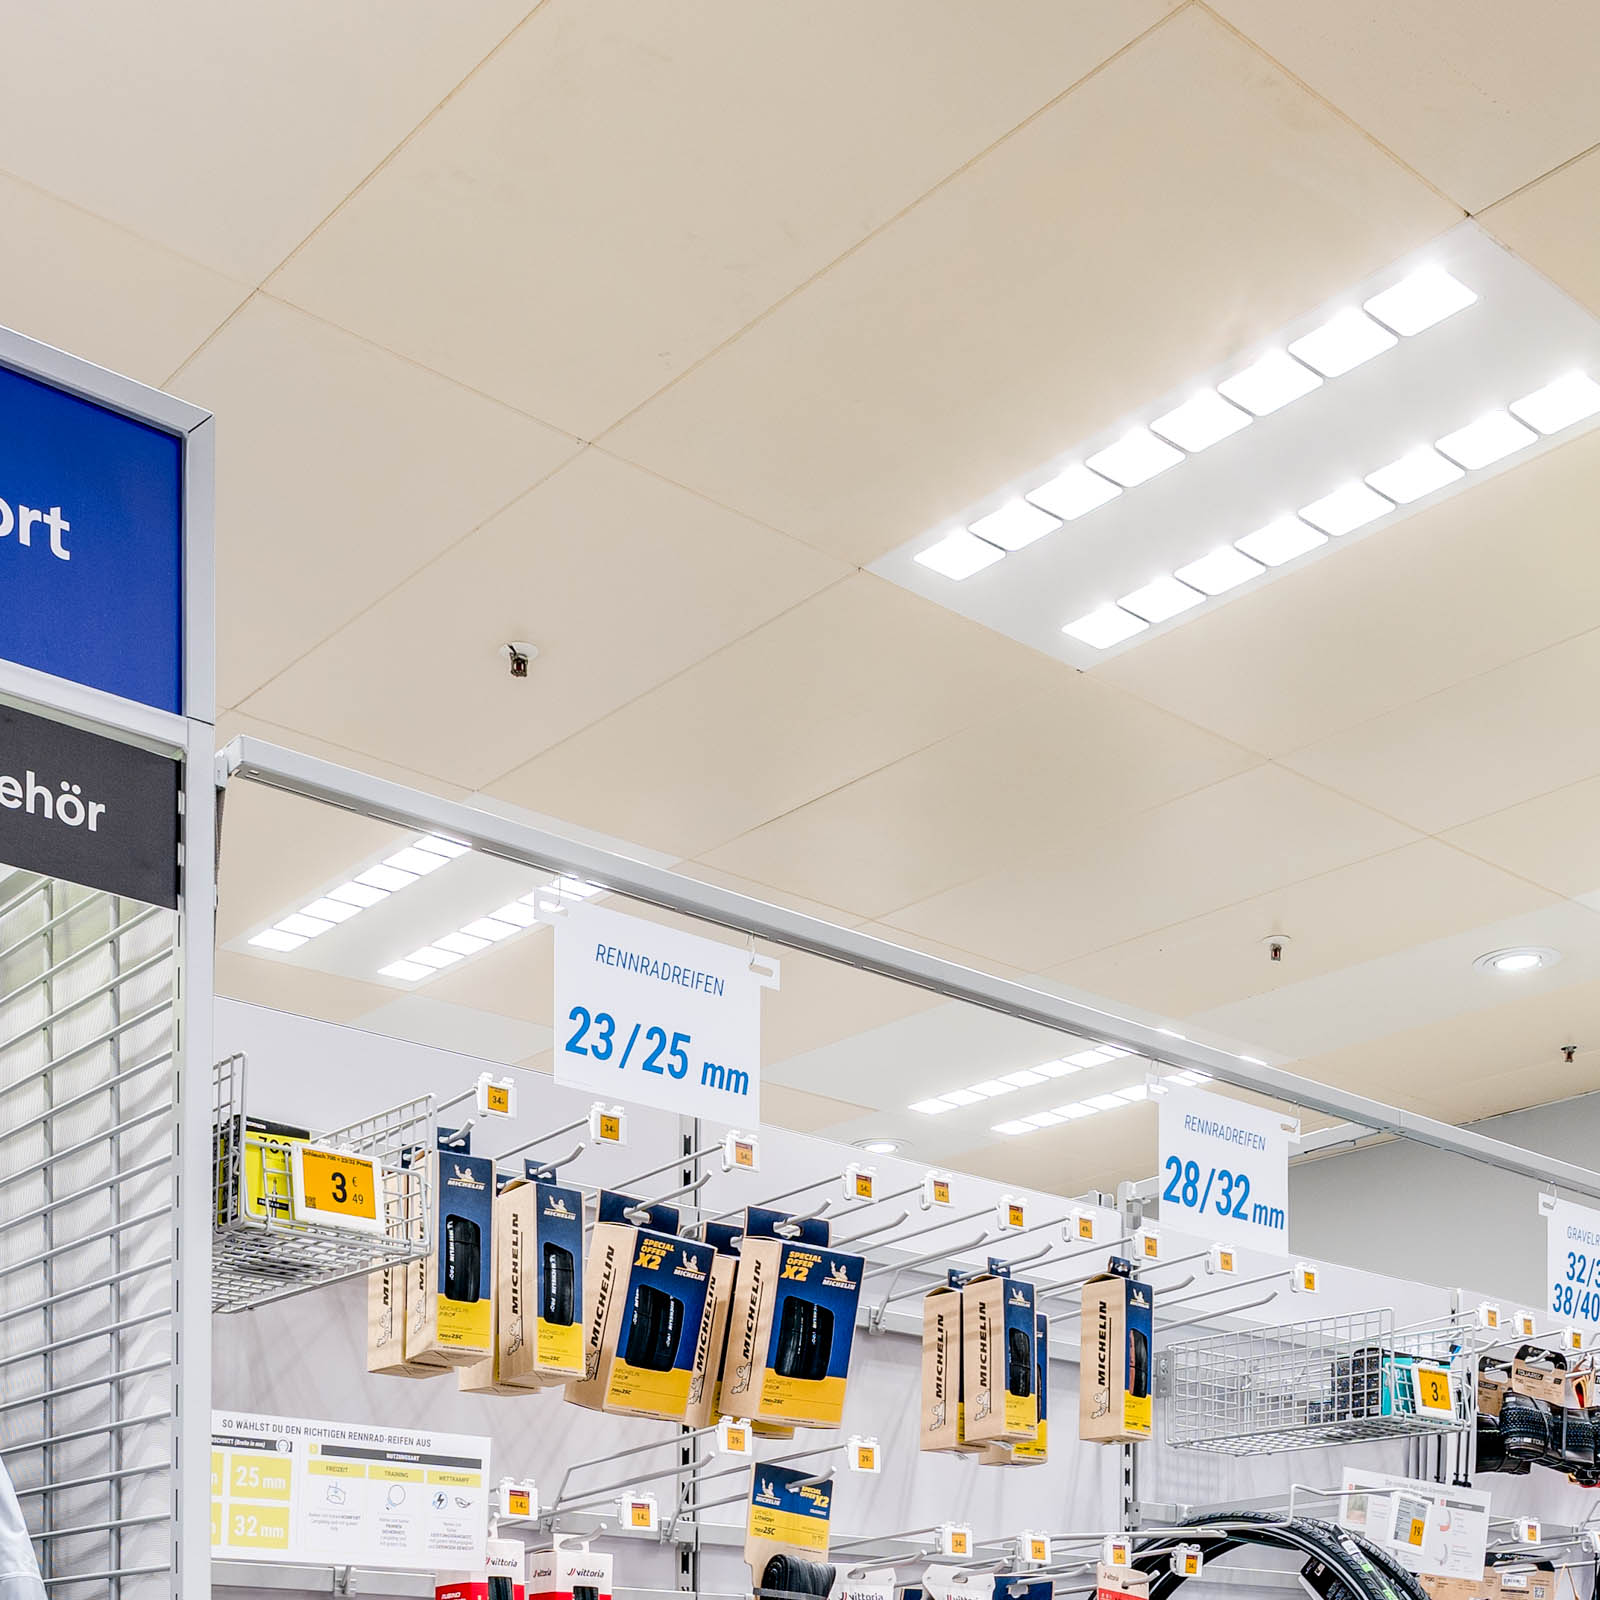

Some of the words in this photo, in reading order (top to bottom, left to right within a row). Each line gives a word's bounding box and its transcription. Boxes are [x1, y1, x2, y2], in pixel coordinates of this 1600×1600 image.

[595, 943, 725, 997] RENNRADREIFEN
[701, 1060, 749, 1096] mm
[1184, 1114, 1266, 1151] RENNRADREIFEN
[330, 1171, 347, 1203] 3
[352, 1194, 364, 1205] 49
[1163, 1155, 1250, 1221] 28/32
[1252, 1202, 1285, 1230] mm
[635, 1252, 660, 1270] X2
[641, 1245, 667, 1258] OFFER
[643, 1238, 675, 1252] SPECIAL
[789, 1251, 823, 1264] SPECIAL
[510, 1212, 520, 1315] MICHELIN
[781, 1264, 808, 1282] X2
[787, 1258, 814, 1270] OFFER
[591, 1245, 615, 1348] MICHELIN
[743, 1259, 763, 1360] MICHELIN
[1552, 1283, 1600, 1322] 38/40
[697, 1276, 717, 1373] MICHELIN
[935, 1314, 945, 1399] MICHELIN
[979, 1301, 988, 1388] MICHELIN
[1098, 1300, 1108, 1387] MICHELIN
[1431, 1382, 1440, 1402] 3
[221, 1419, 234, 1429] SO
[272, 1423, 283, 1434] DU
[285, 1425, 301, 1435] DEN
[303, 1427, 346, 1440] RICHTIGEN
[348, 1430, 414, 1446] RENNRAD-REIFEN
[415, 1437, 432, 1448] AUS
[235, 1465, 259, 1488] 25
[262, 1474, 286, 1490] mm
[233, 1515, 258, 1537] 32
[260, 1524, 284, 1539] mm
[576, 1570, 605, 1578] vittoria
